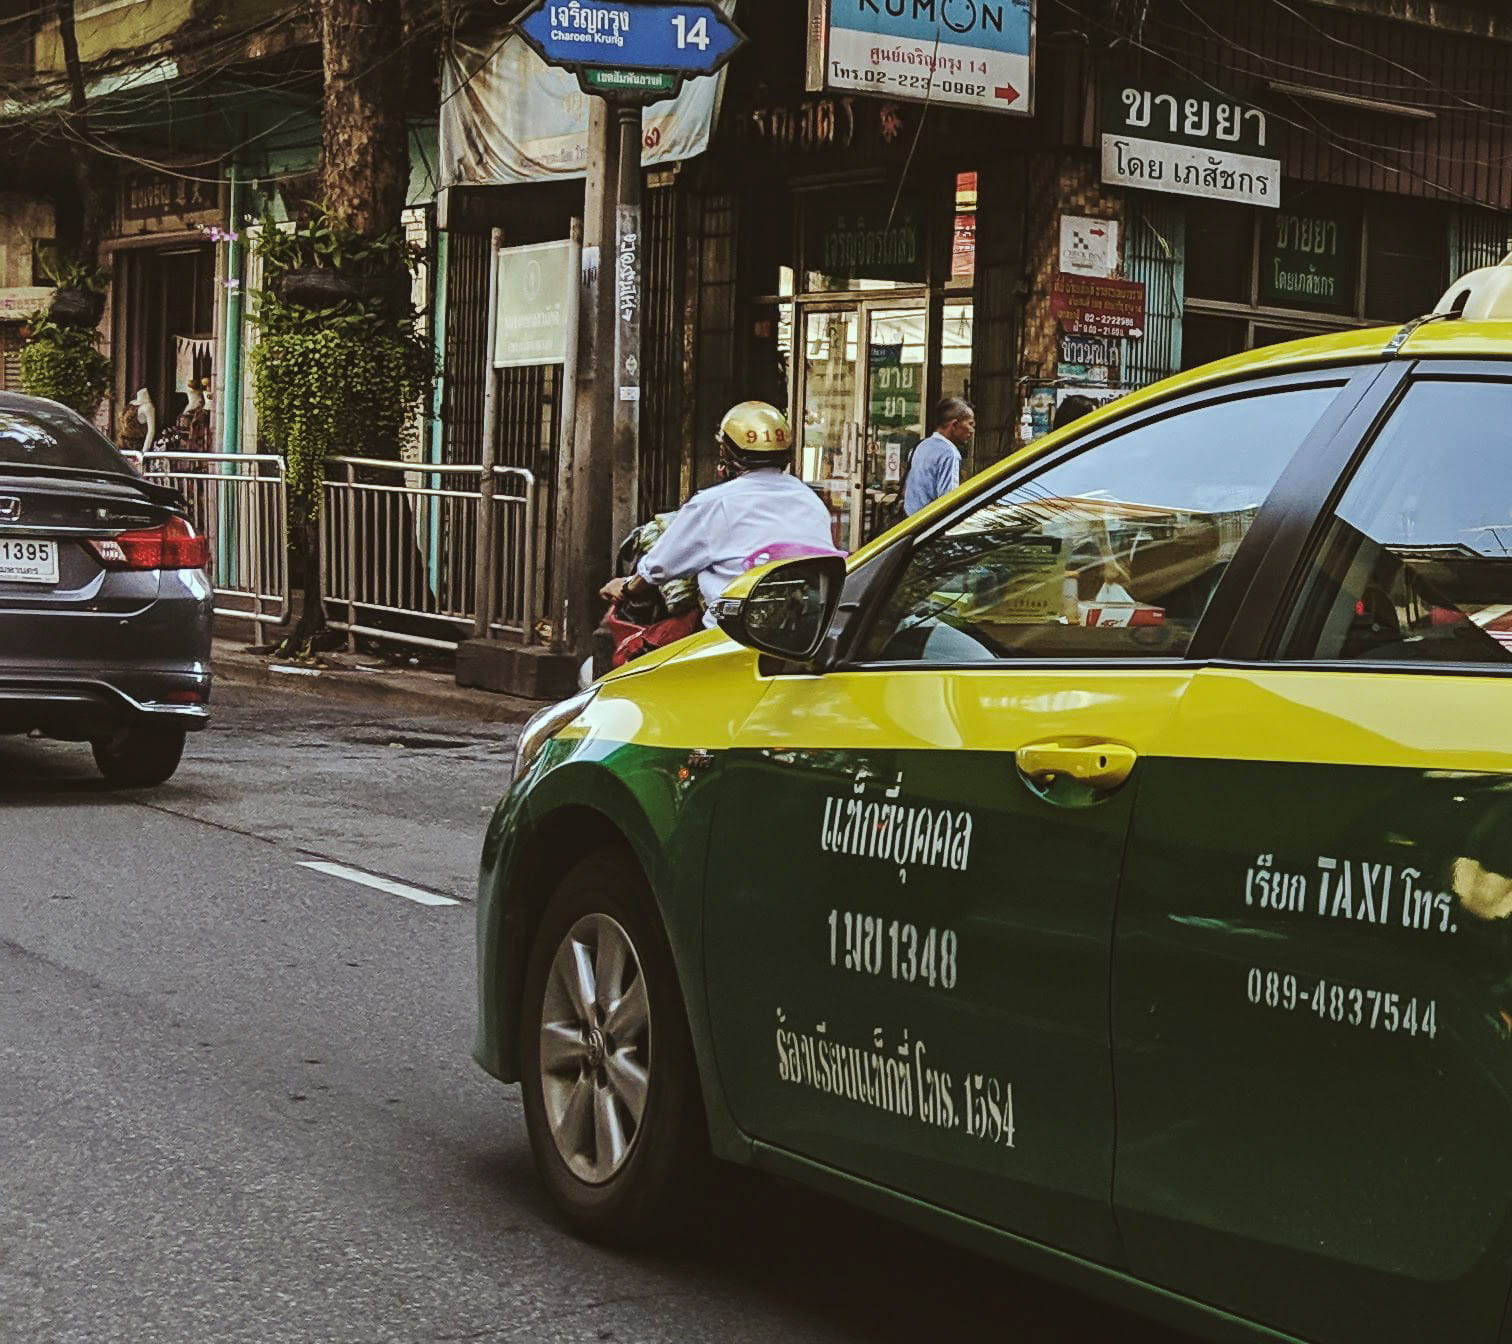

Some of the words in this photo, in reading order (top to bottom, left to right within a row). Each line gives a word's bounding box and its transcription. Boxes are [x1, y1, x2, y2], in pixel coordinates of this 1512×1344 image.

[550, 0, 630, 37] เจริญกรุง
[672, 15, 710, 51] 14
[551, 30, 592, 43] Charoen
[594, 33, 624, 47] Krung
[969, 60, 987, 75] 14
[1121, 88, 1266, 147] ขายยา
[1113, 141, 1163, 180] โดย
[1174, 156, 1269, 196] เภสัชกร
[1276, 215, 1336, 255] ขายยา
[878, 367, 913, 389] ขาย
[884, 396, 906, 418] ยา
[3, 542, 49, 561] 1395
[821, 770, 973, 885] แท็กซี่บุคคล
[1245, 854, 1306, 912] เรียก
[1317, 856, 1392, 924] TAXI
[1400, 867, 1457, 933] โทร.
[1247, 968, 1437, 1039] 089-4837544
[964, 1072, 1016, 1148] 1584
